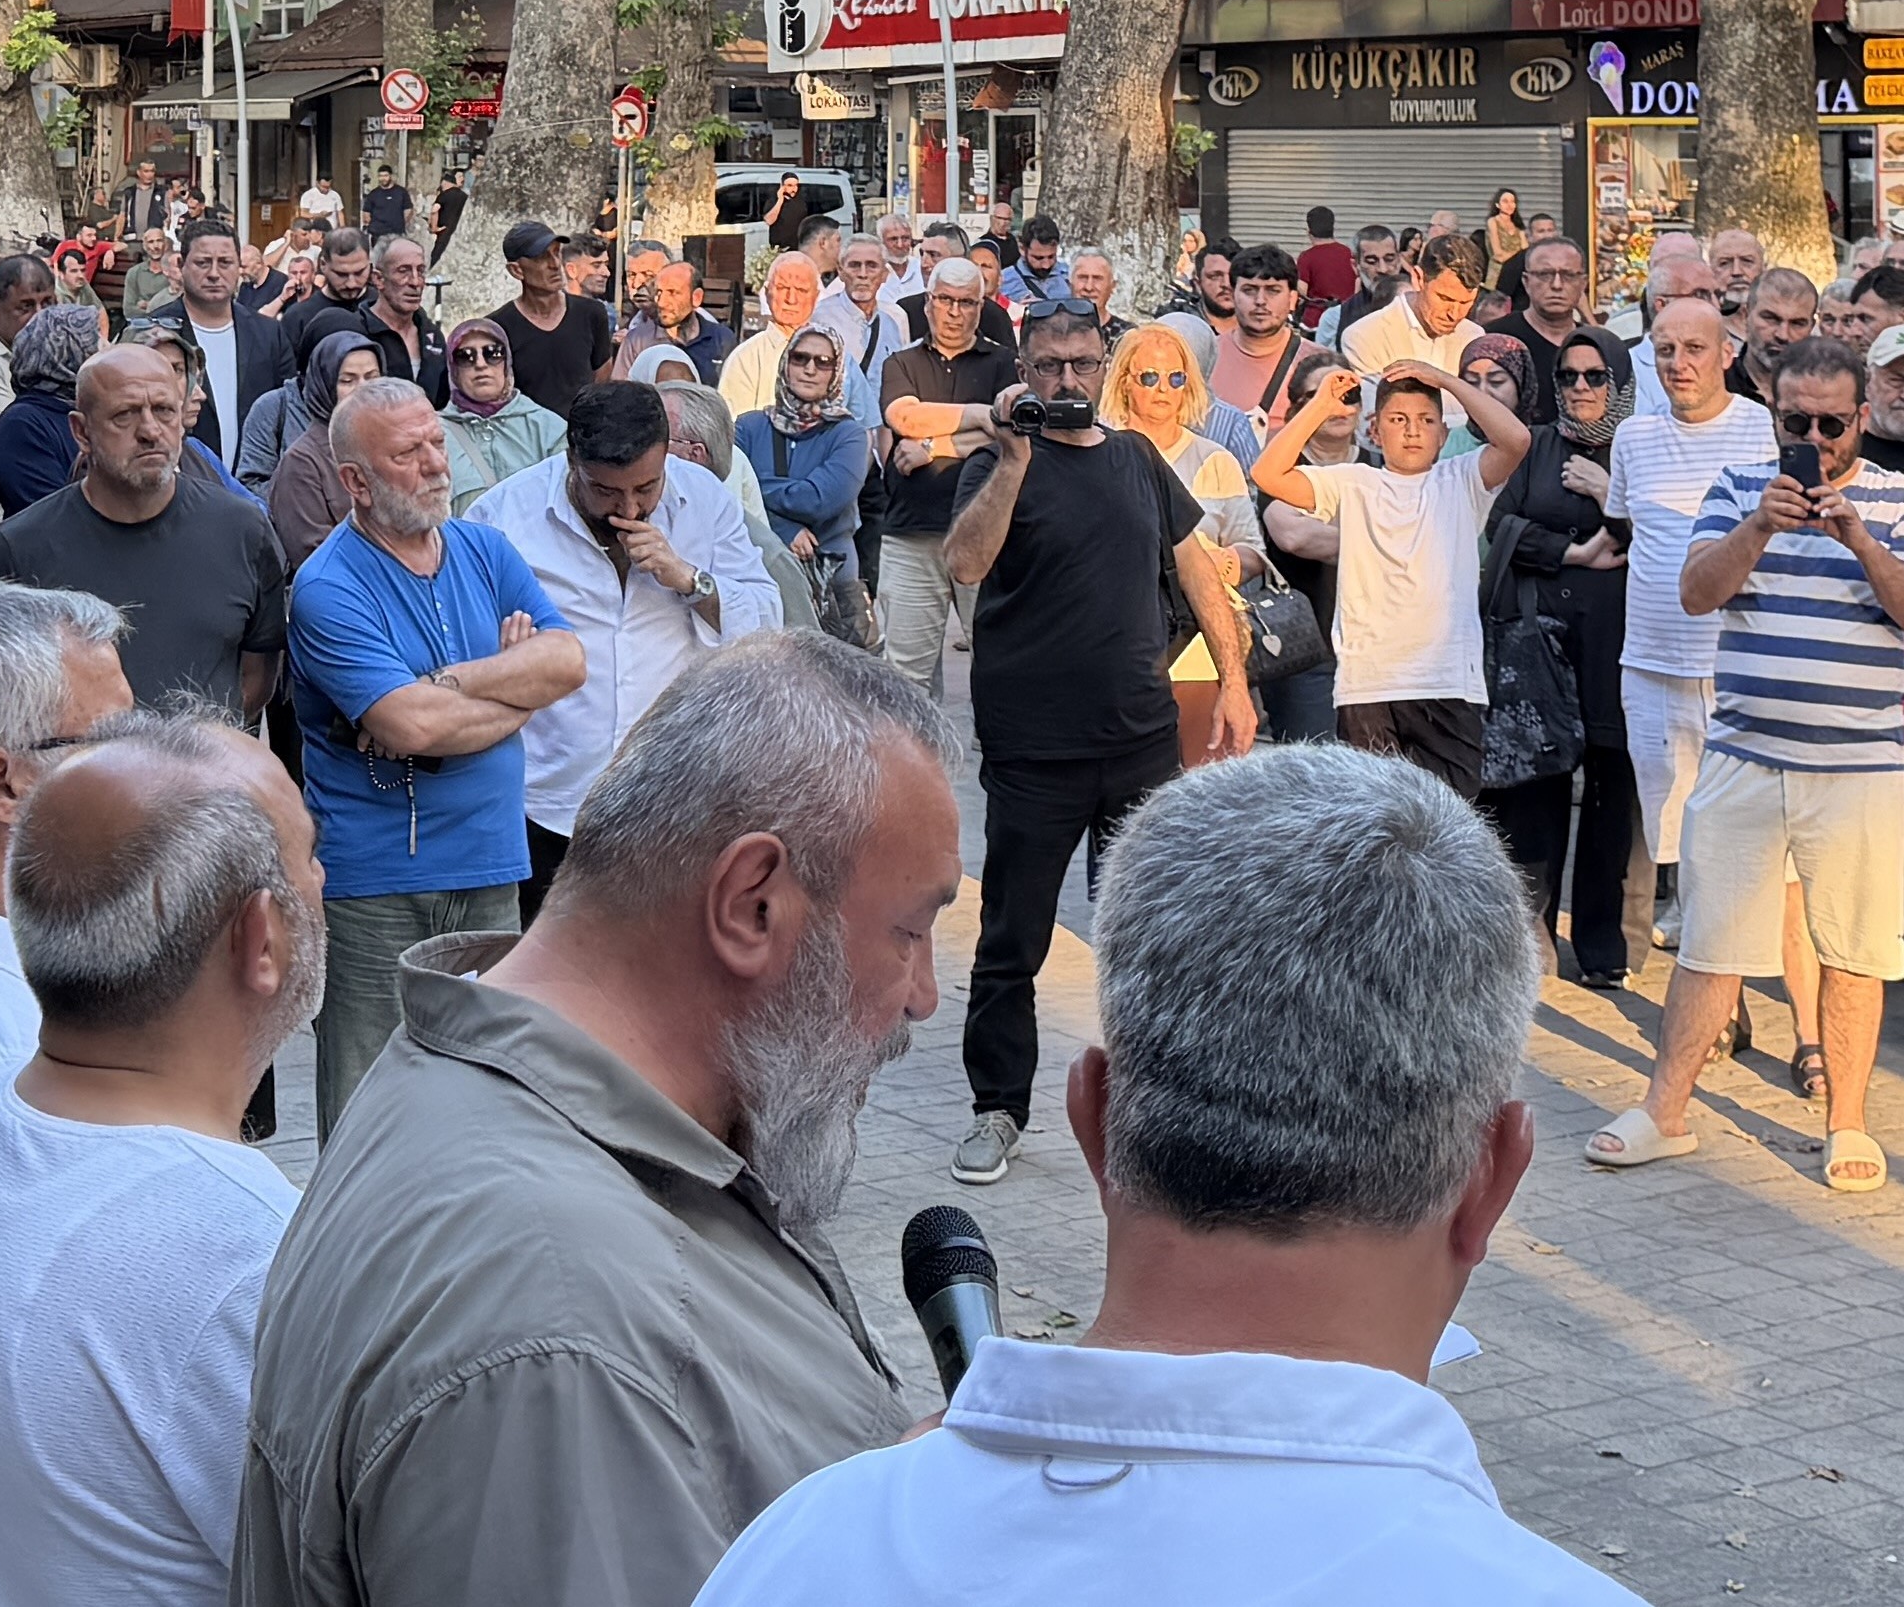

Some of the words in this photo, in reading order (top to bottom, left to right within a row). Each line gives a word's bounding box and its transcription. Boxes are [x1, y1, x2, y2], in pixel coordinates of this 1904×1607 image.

[1559, 0, 1607, 28] Lord
[1640, 41, 1685, 73] MARAŞ
[1293, 44, 1477, 99] KÜÇÜKÇAKIR
[809, 95, 871, 109] LOKANTASI
[1390, 98, 1478, 122] KUYUMCULUK
